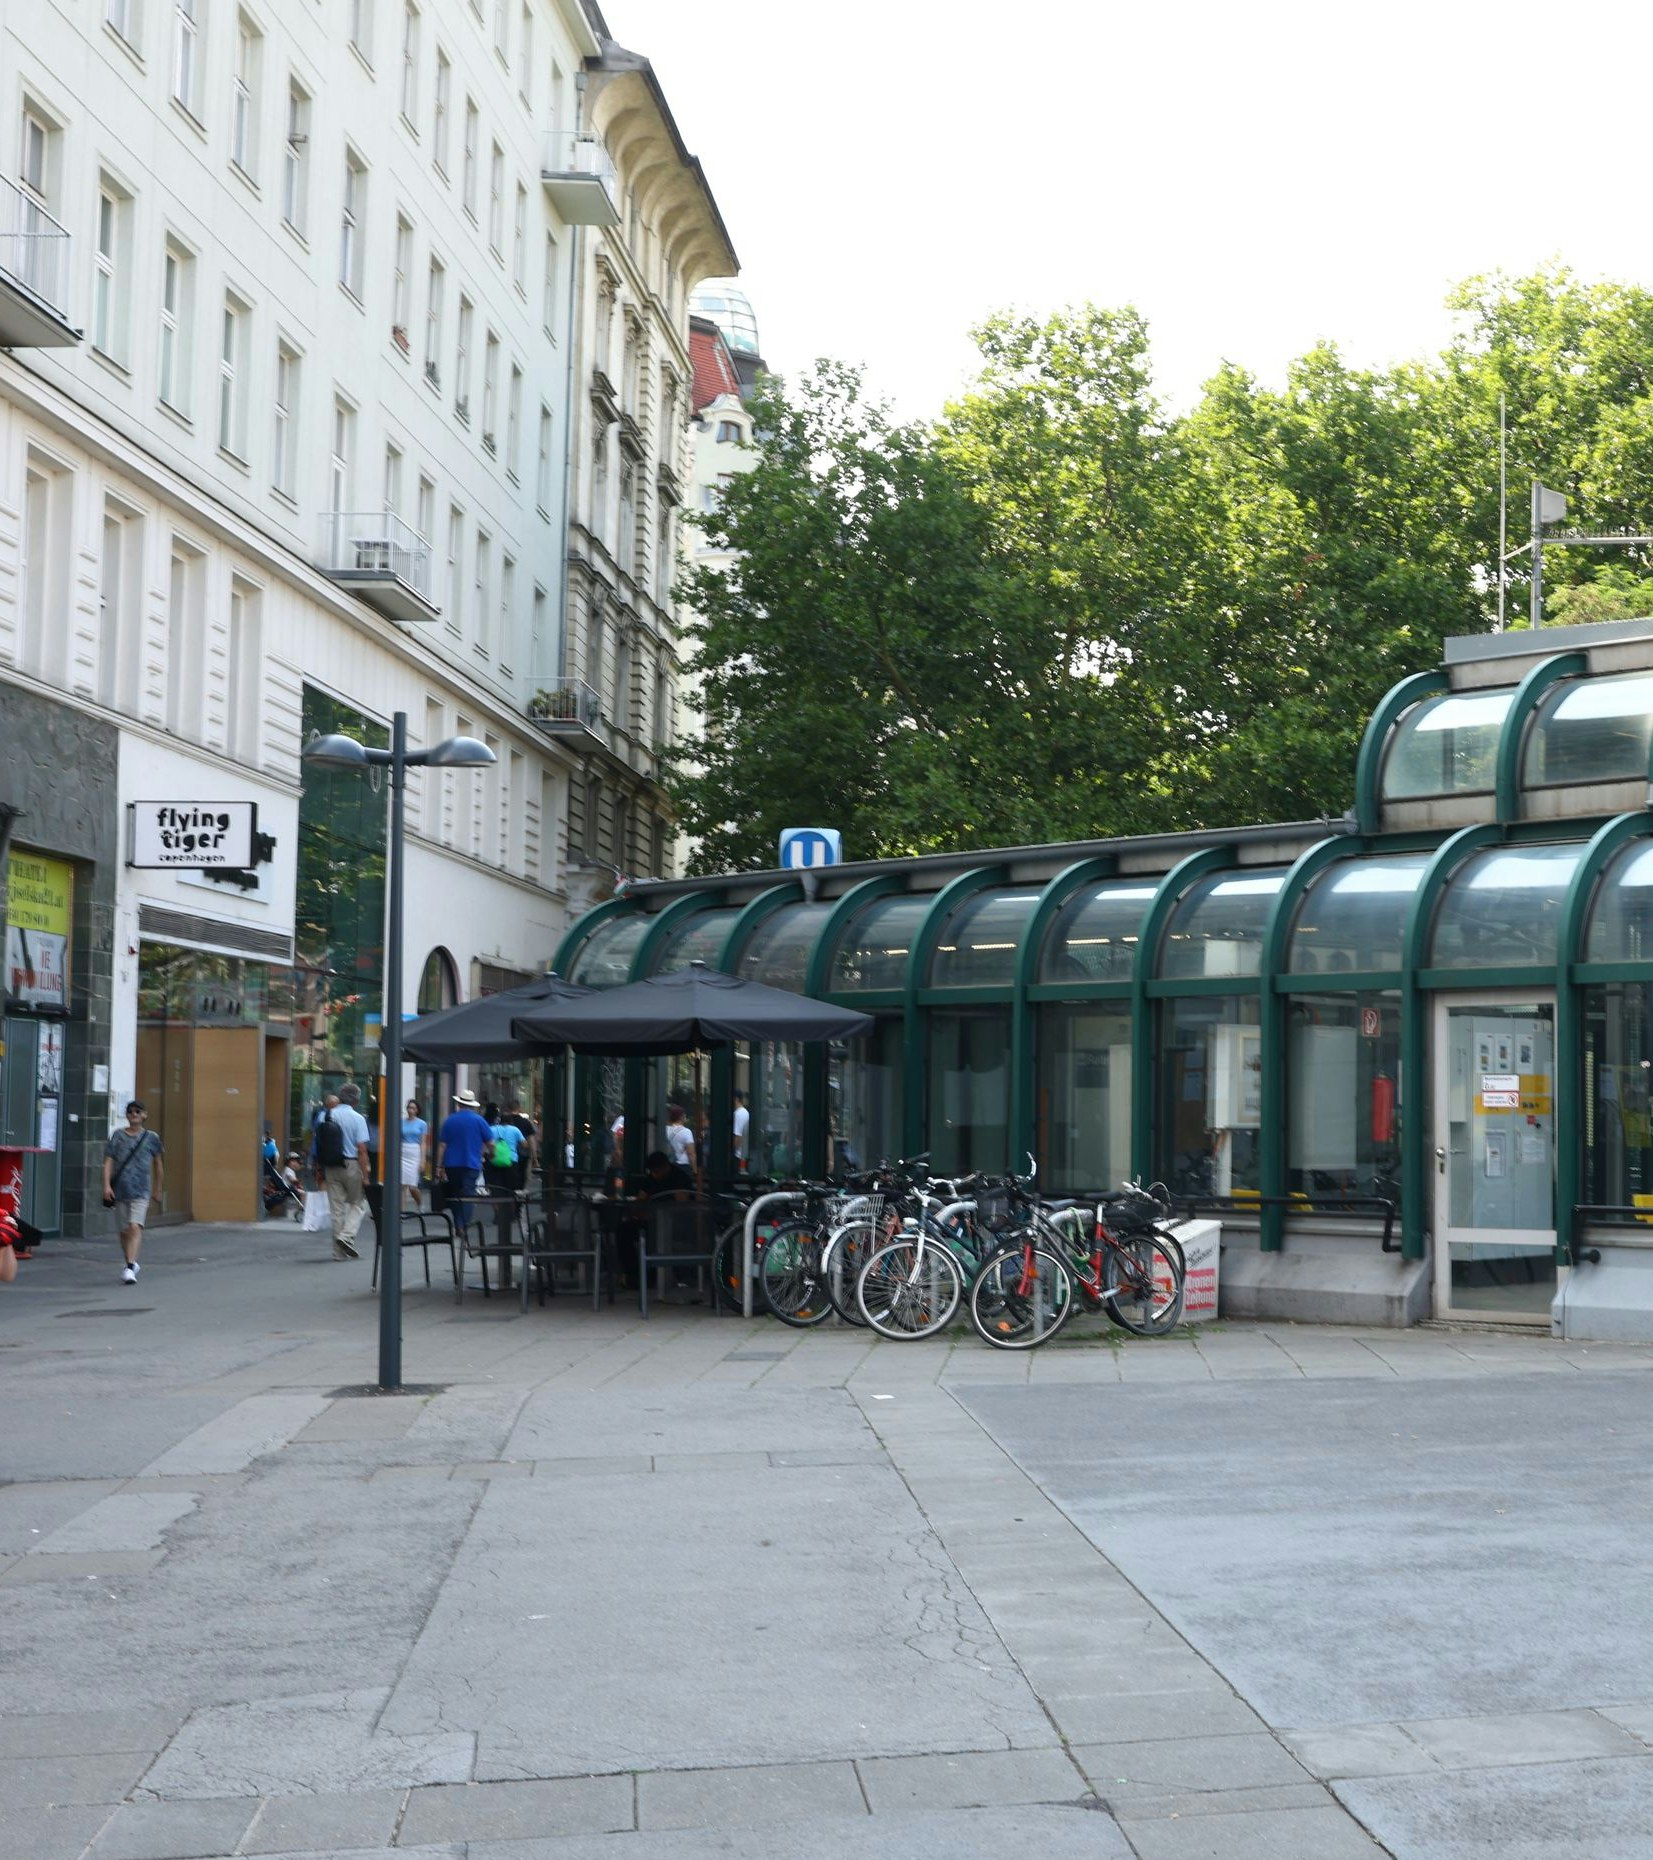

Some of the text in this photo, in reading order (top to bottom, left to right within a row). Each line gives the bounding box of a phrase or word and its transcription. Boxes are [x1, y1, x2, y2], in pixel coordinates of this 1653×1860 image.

[157, 807, 230, 831] flying
[160, 829, 226, 852] tiger
[158, 853, 226, 863] copenhagen
[791, 840, 825, 869] U
